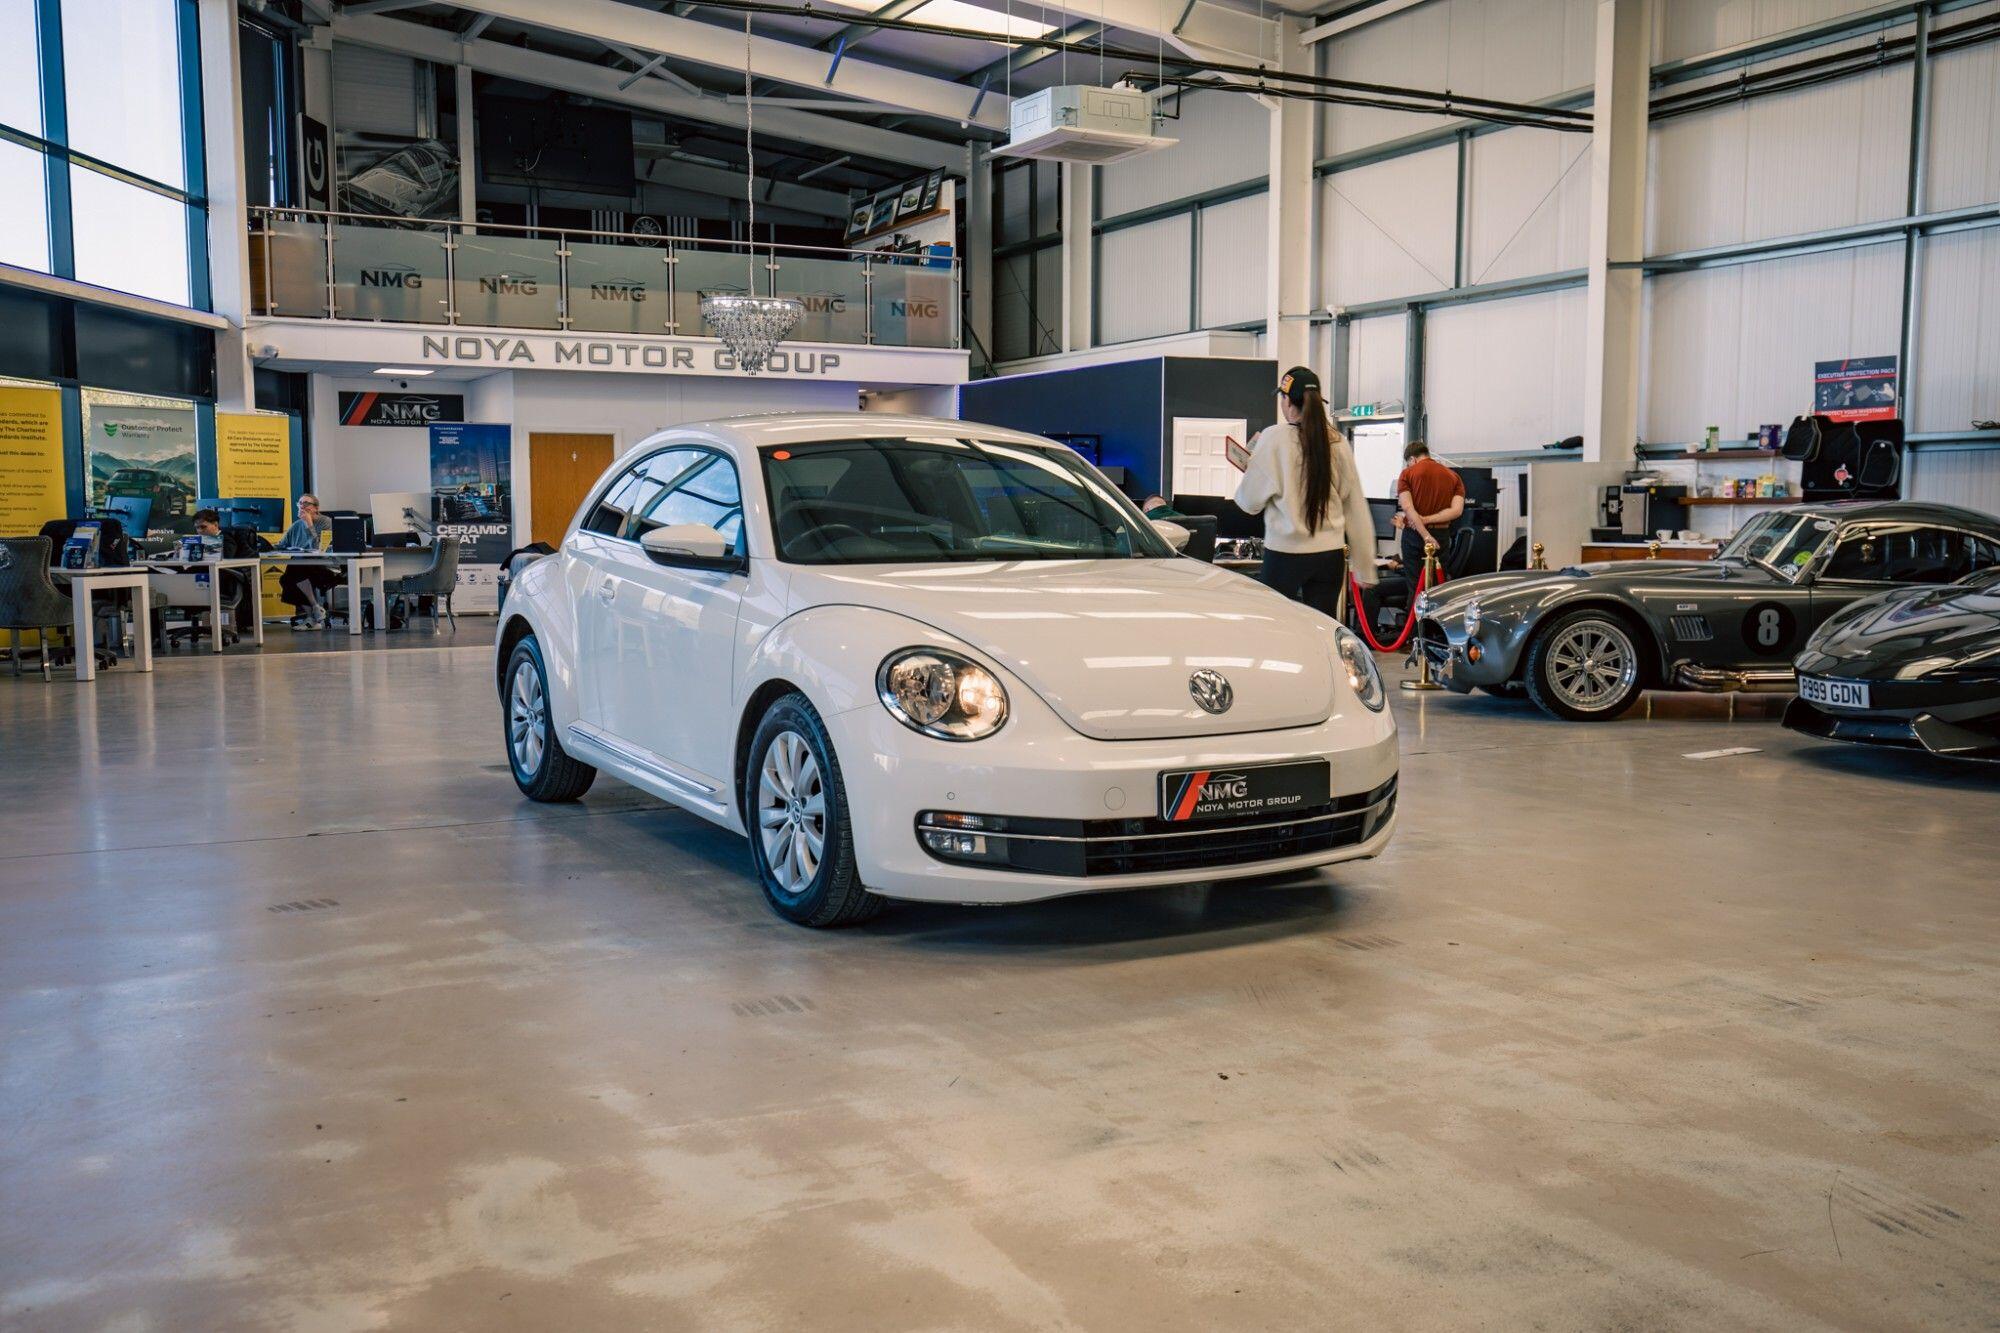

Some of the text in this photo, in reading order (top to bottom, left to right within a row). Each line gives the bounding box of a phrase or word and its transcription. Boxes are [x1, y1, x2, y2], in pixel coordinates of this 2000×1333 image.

[360, 269, 423, 289] NMG
[479, 277, 538, 296] NMG
[590, 284, 647, 302] NMG
[891, 302, 938, 319] NMG
[423, 335, 840, 374] NOYA MOTOR GOUP
[380, 403, 441, 420] NMG
[121, 424, 183, 433] Customer Protect
[147, 527, 175, 535] hensive
[436, 524, 508, 535] CERAMIC
[1757, 608, 1780, 646] 8
[1802, 678, 1863, 705] P999 GDN
[1196, 781, 1249, 801] NMG
[1196, 803, 1224, 813] NOYA
[1227, 798, 1264, 810] MOTOR
[1266, 795, 1302, 806] GROUP
